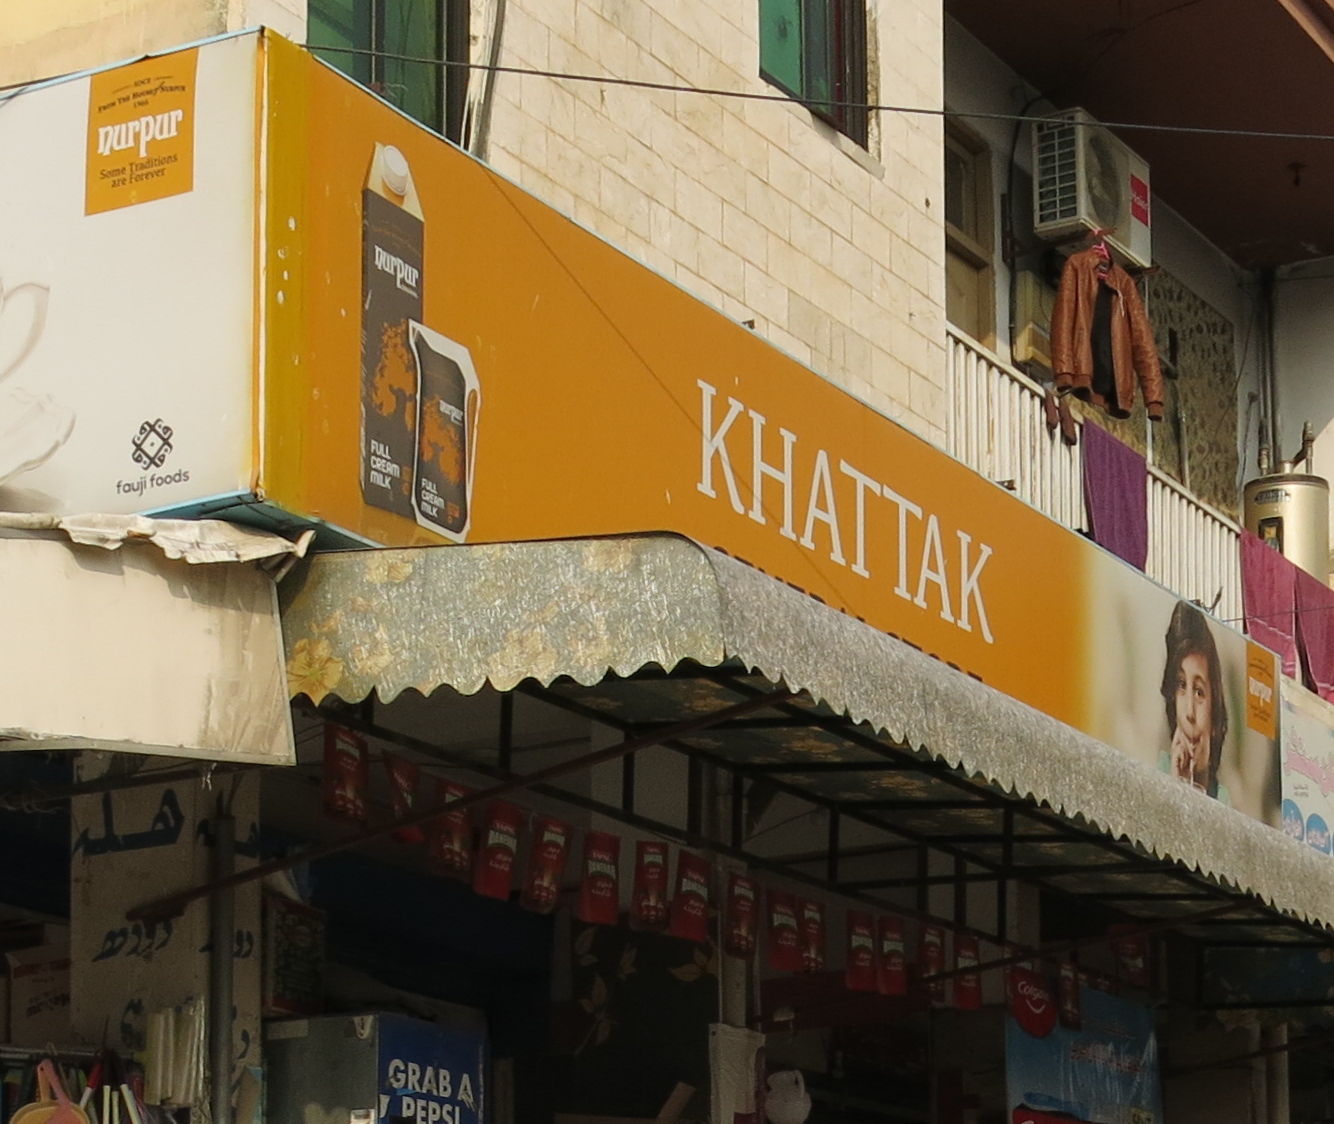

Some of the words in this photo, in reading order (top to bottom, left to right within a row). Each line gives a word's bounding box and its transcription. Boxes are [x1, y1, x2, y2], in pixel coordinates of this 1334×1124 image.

[100, 167, 126, 179] Some
[128, 154, 177, 172] Traditions
[111, 178, 126, 188] are
[129, 168, 166, 184] Forever
[370, 438, 391, 459] FULL
[370, 455, 400, 478] CREAM
[116, 475, 147, 498] fauji
[149, 469, 190, 488] foods
[370, 471, 391, 490] MILK
[421, 477, 437, 492] FULL
[421, 501, 437, 518] MILK
[697, 379, 994, 644] KHATTAK
[388, 1058, 452, 1098] GRAB
[458, 1073, 475, 1103] A
